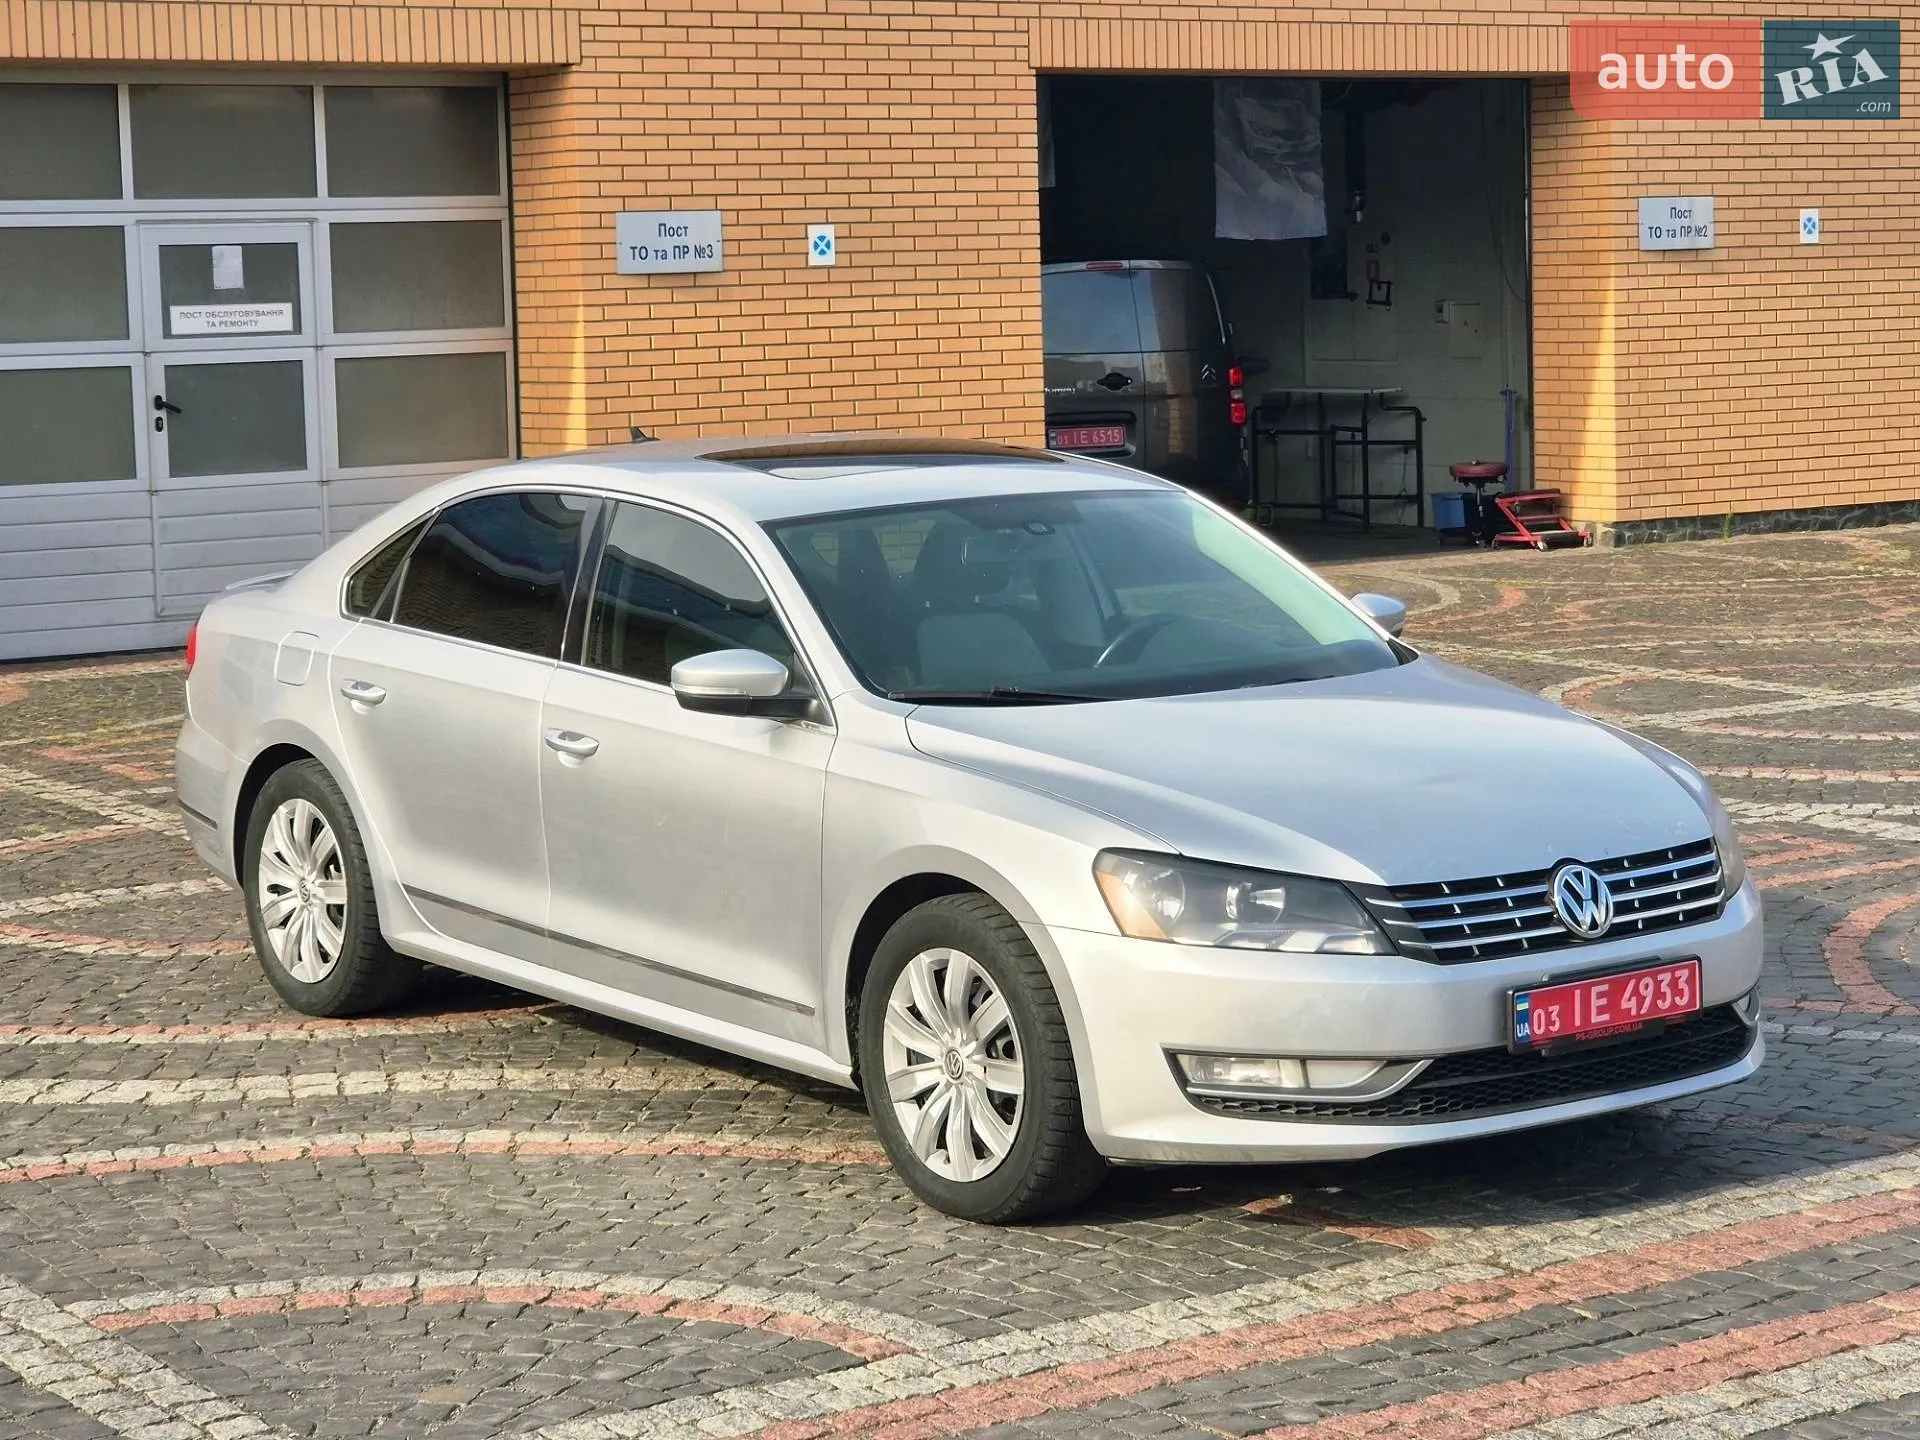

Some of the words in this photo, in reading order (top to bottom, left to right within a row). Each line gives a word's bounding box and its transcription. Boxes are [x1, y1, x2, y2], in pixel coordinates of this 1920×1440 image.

[1670, 206, 1693, 219] Пост
[658, 223, 689, 237] Пост
[1648, 226, 1662, 239] ТО
[1665, 229, 1677, 238] та
[1680, 225, 1692, 238] ПР
[1695, 224, 1708, 238] №2
[629, 246, 649, 260] ТО
[653, 249, 668, 260] та
[673, 245, 690, 260] ПР
[694, 244, 714, 259] №3
[180, 311, 202, 320] ПОСТ
[205, 309, 284, 319] ОБСЛУГОВУВАННЯ
[219, 319, 259, 328] РЕМОНТУ
[1073, 431, 1089, 444] IE
[1092, 429, 1120, 443] 6515
[1554, 864, 1614, 939] VW
[1532, 1005, 1560, 1035] 03
[1573, 984, 1610, 1027] IE
[1620, 968, 1690, 1017] 4933
[1516, 1022, 1531, 1037] UA
